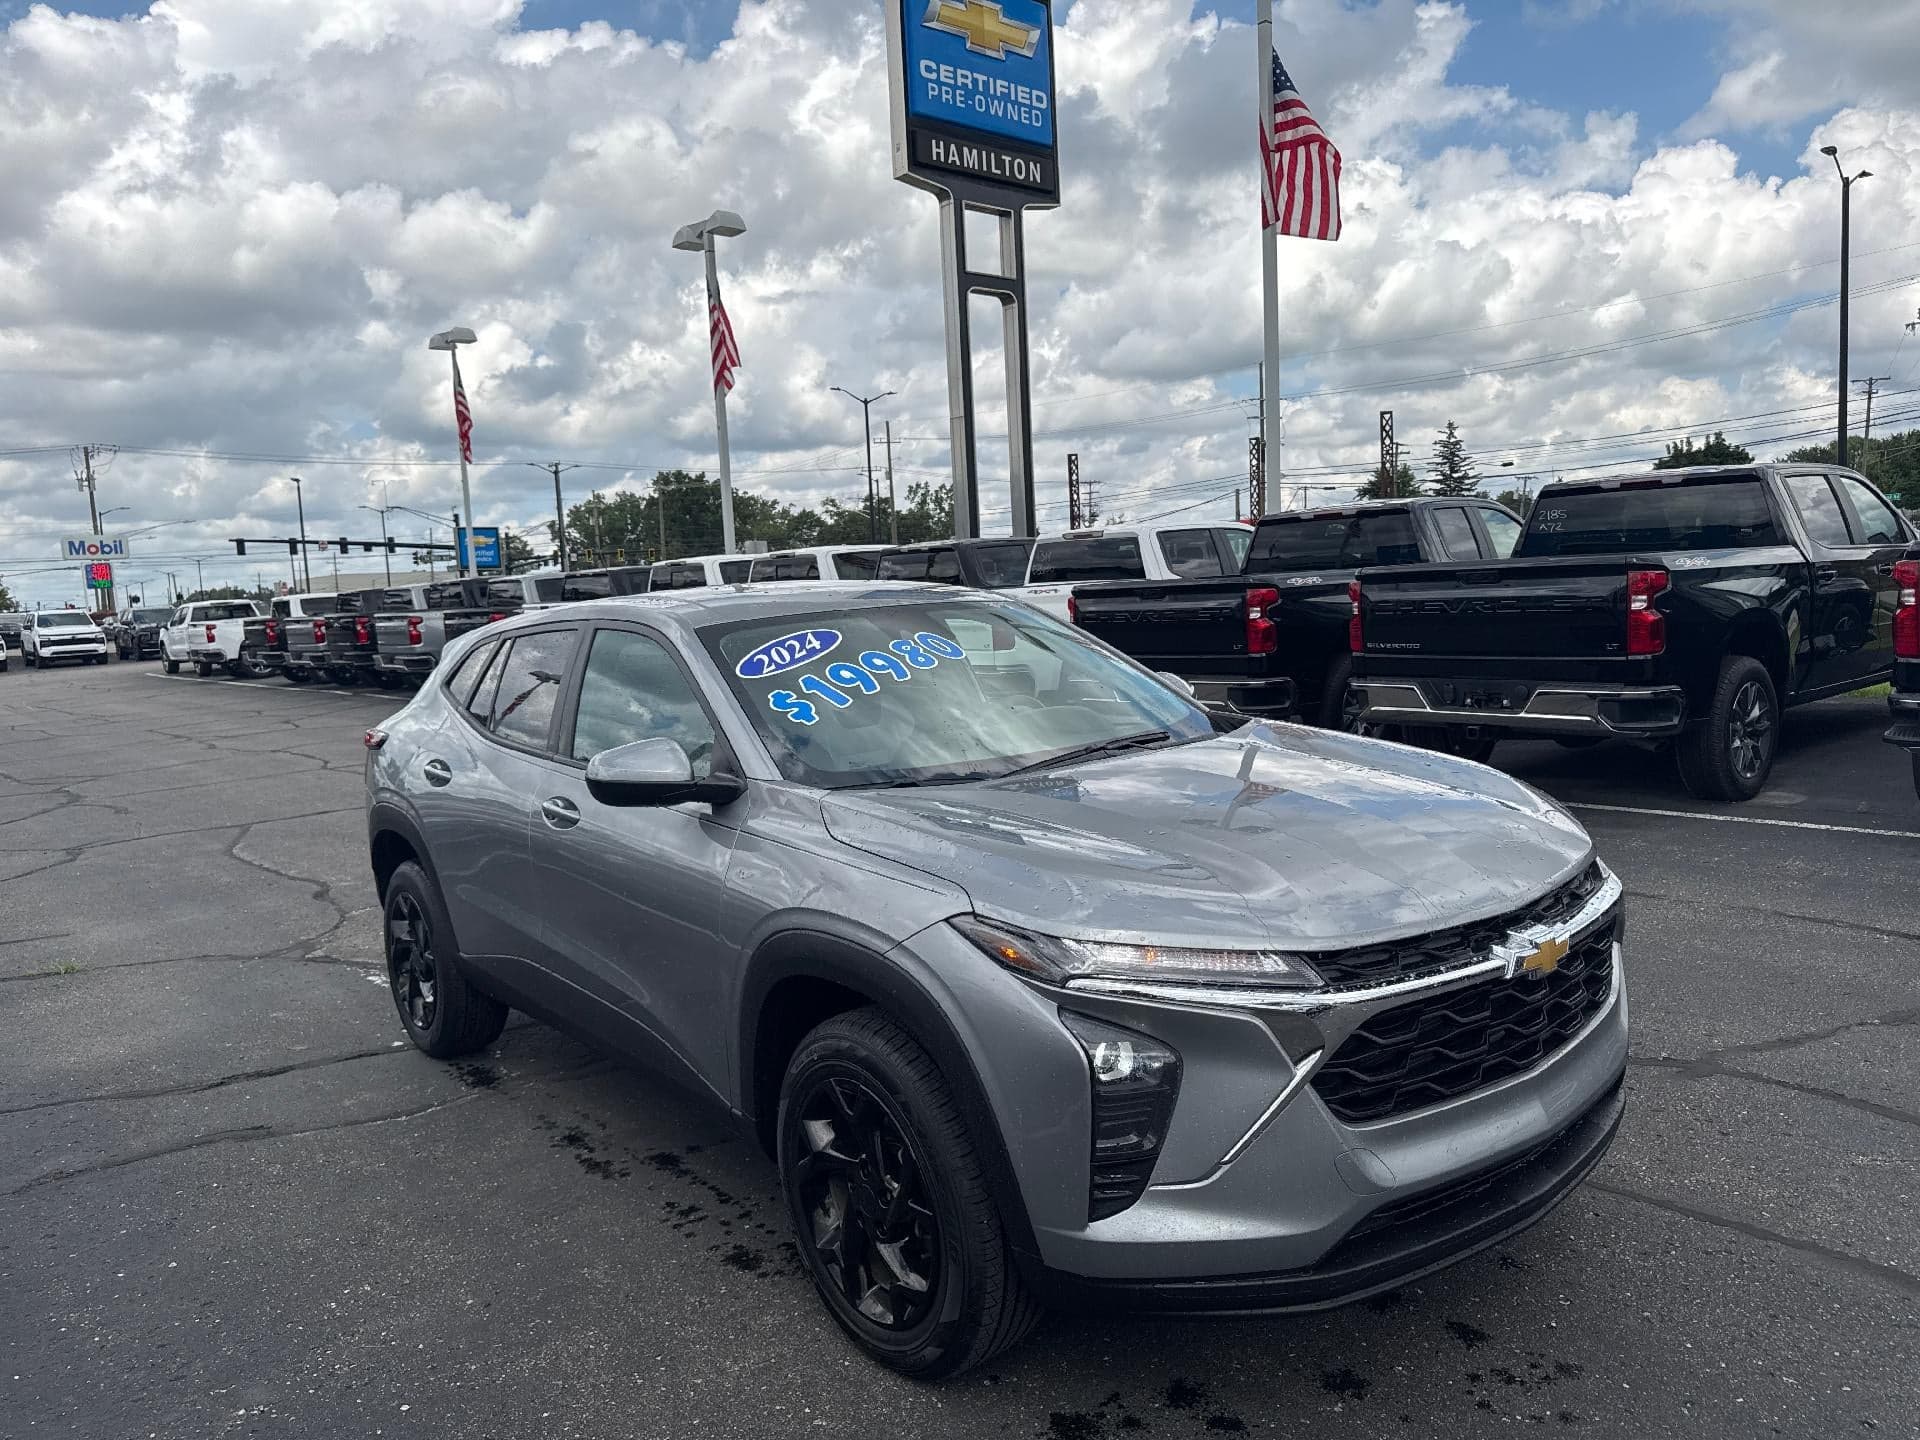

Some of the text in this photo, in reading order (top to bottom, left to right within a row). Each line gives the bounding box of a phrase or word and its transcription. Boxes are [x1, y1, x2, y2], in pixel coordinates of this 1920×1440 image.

[919, 59, 1048, 109] CERTIFIED
[928, 83, 1042, 127] PRE-OWNED
[931, 139, 1041, 183] HAMILTON
[1539, 510, 1567, 520] 2185
[68, 540, 123, 555] Mobil
[753, 632, 821, 674] 2024
[768, 631, 966, 725] $19980
